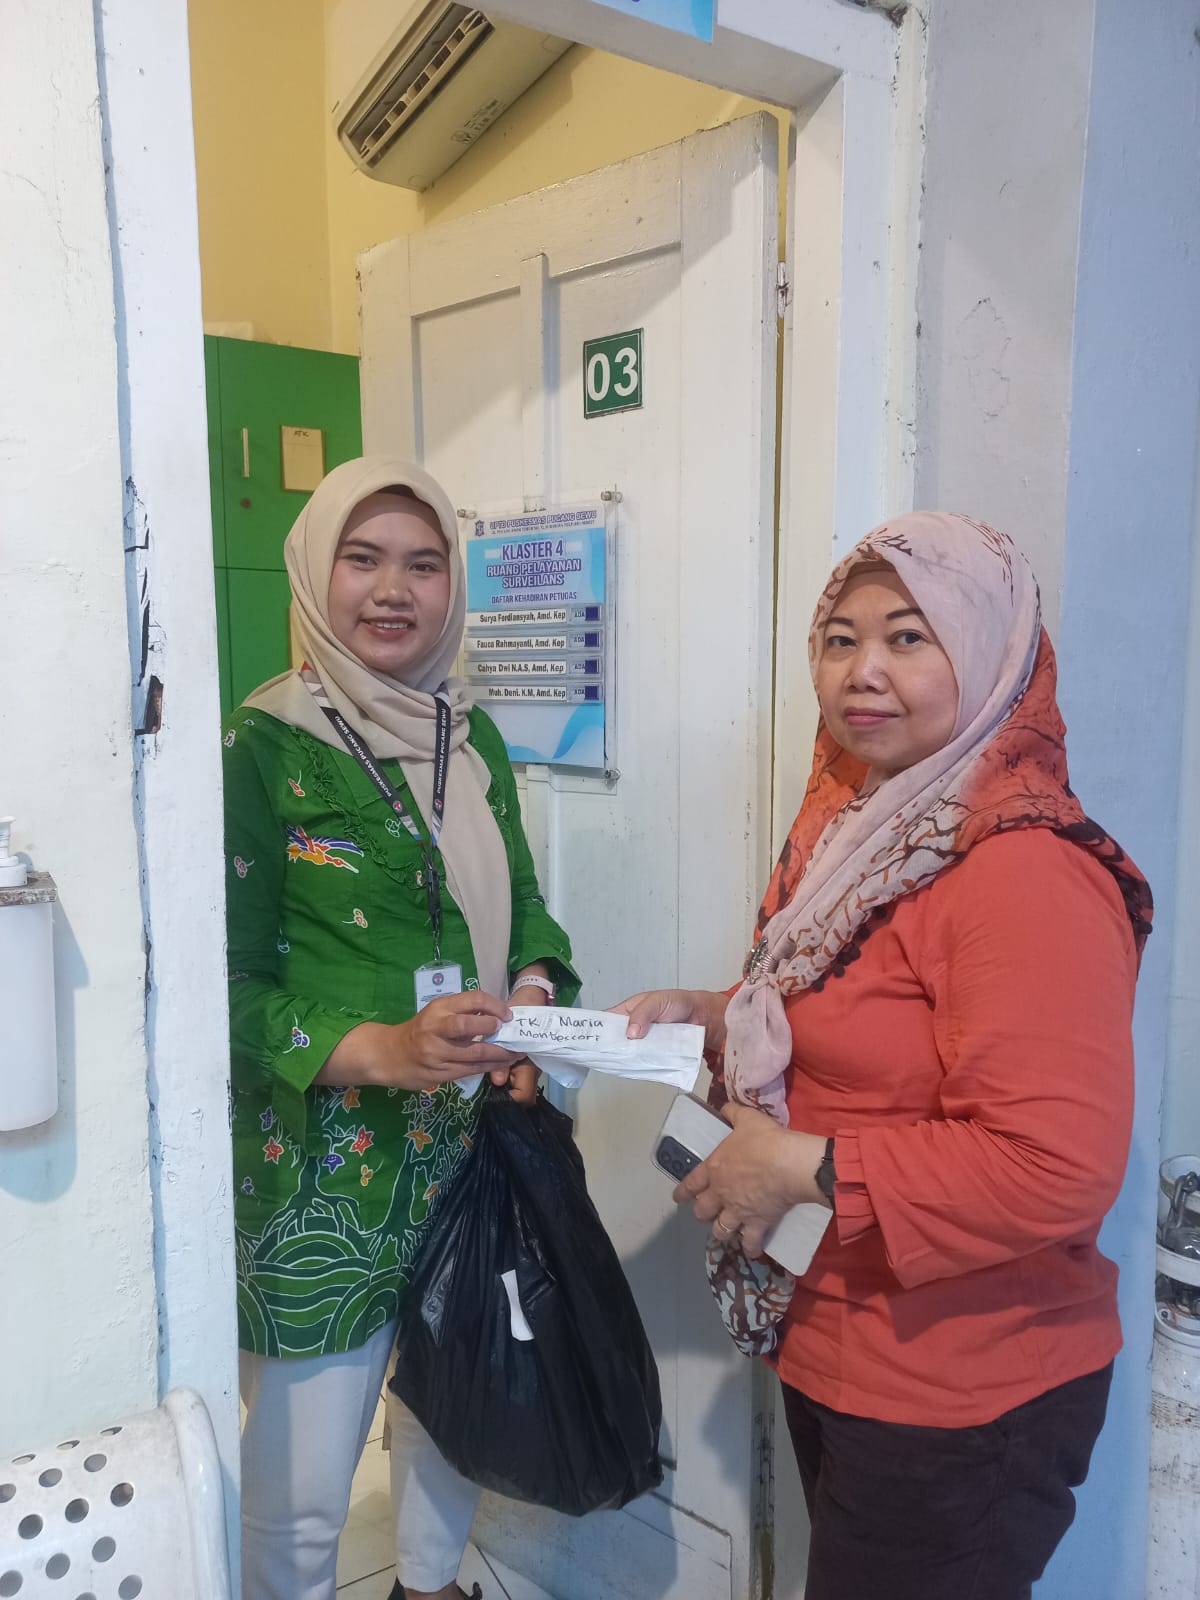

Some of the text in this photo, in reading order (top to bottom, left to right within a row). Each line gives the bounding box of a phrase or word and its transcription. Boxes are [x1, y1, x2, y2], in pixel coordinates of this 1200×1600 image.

[587, 347, 638, 401] 03
[506, 516, 546, 528] PUSKESMAS
[547, 513, 575, 524] PUCANG
[575, 510, 597, 520] SEWU
[502, 539, 564, 561] KLASTER 4
[487, 559, 581, 577] RUANG PELAYANAN
[502, 573, 564, 589] SURVEILANS
[491, 591, 577, 604] DAFTAR KEHADIRAN PETUGAS
[480, 613, 497, 624] Surya
[553, 610, 566, 621] Kep
[552, 638, 565, 649] Kep
[477, 663, 497, 674] Cahya
[498, 663, 511, 672] Dwi
[550, 663, 564, 674] Kep
[553, 688, 566, 699] Kep
[334, 715, 393, 797] PUSKESMAS PUCANG SEWU
[515, 1016, 604, 1027] TK Maria
